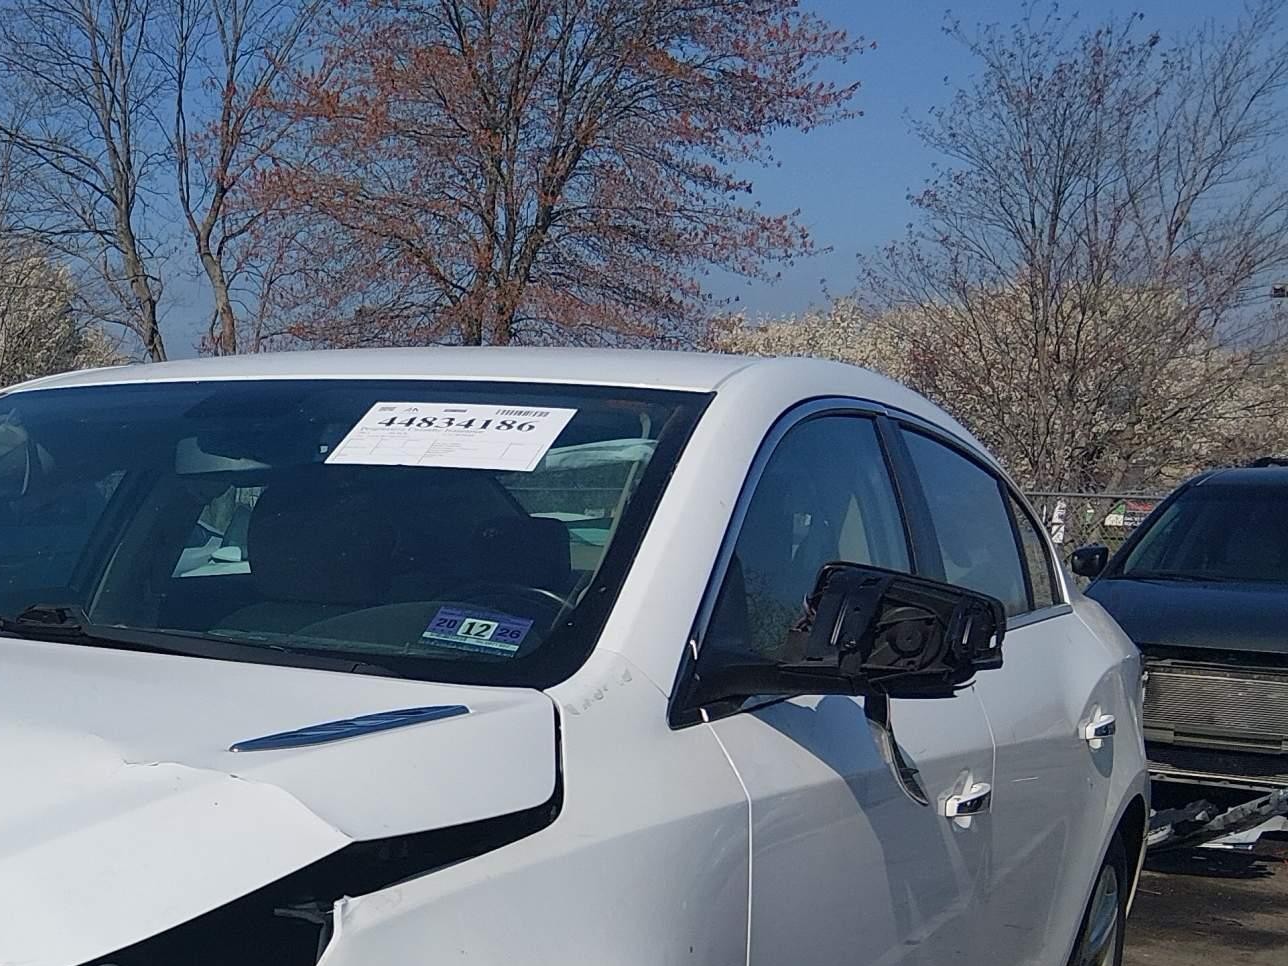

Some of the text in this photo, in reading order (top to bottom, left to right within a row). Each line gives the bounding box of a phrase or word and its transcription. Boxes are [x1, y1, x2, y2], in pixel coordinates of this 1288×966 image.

[378, 416, 538, 433] 44834186
[436, 618, 457, 629] 20
[461, 621, 492, 638] 12
[497, 628, 521, 639] 26
